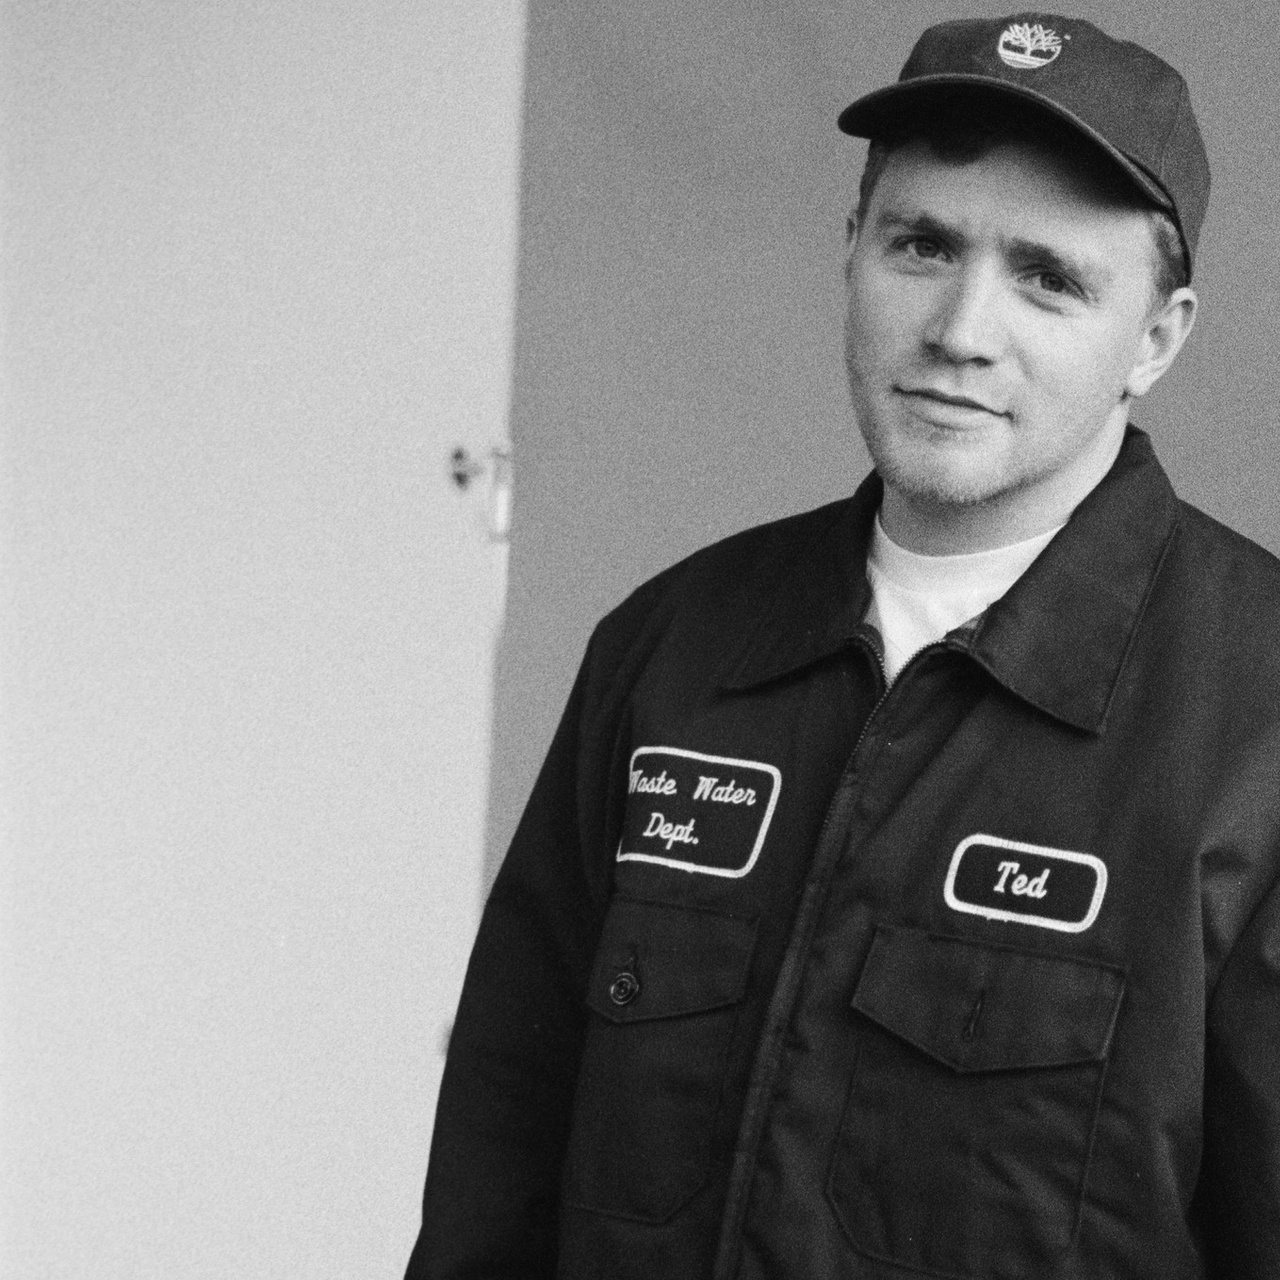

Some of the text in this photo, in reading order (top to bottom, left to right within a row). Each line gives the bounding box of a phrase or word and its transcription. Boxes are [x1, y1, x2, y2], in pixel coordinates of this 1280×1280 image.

[693, 775, 756, 806] Water
[642, 812, 699, 850] Dept.
[993, 861, 1050, 899] Ted
